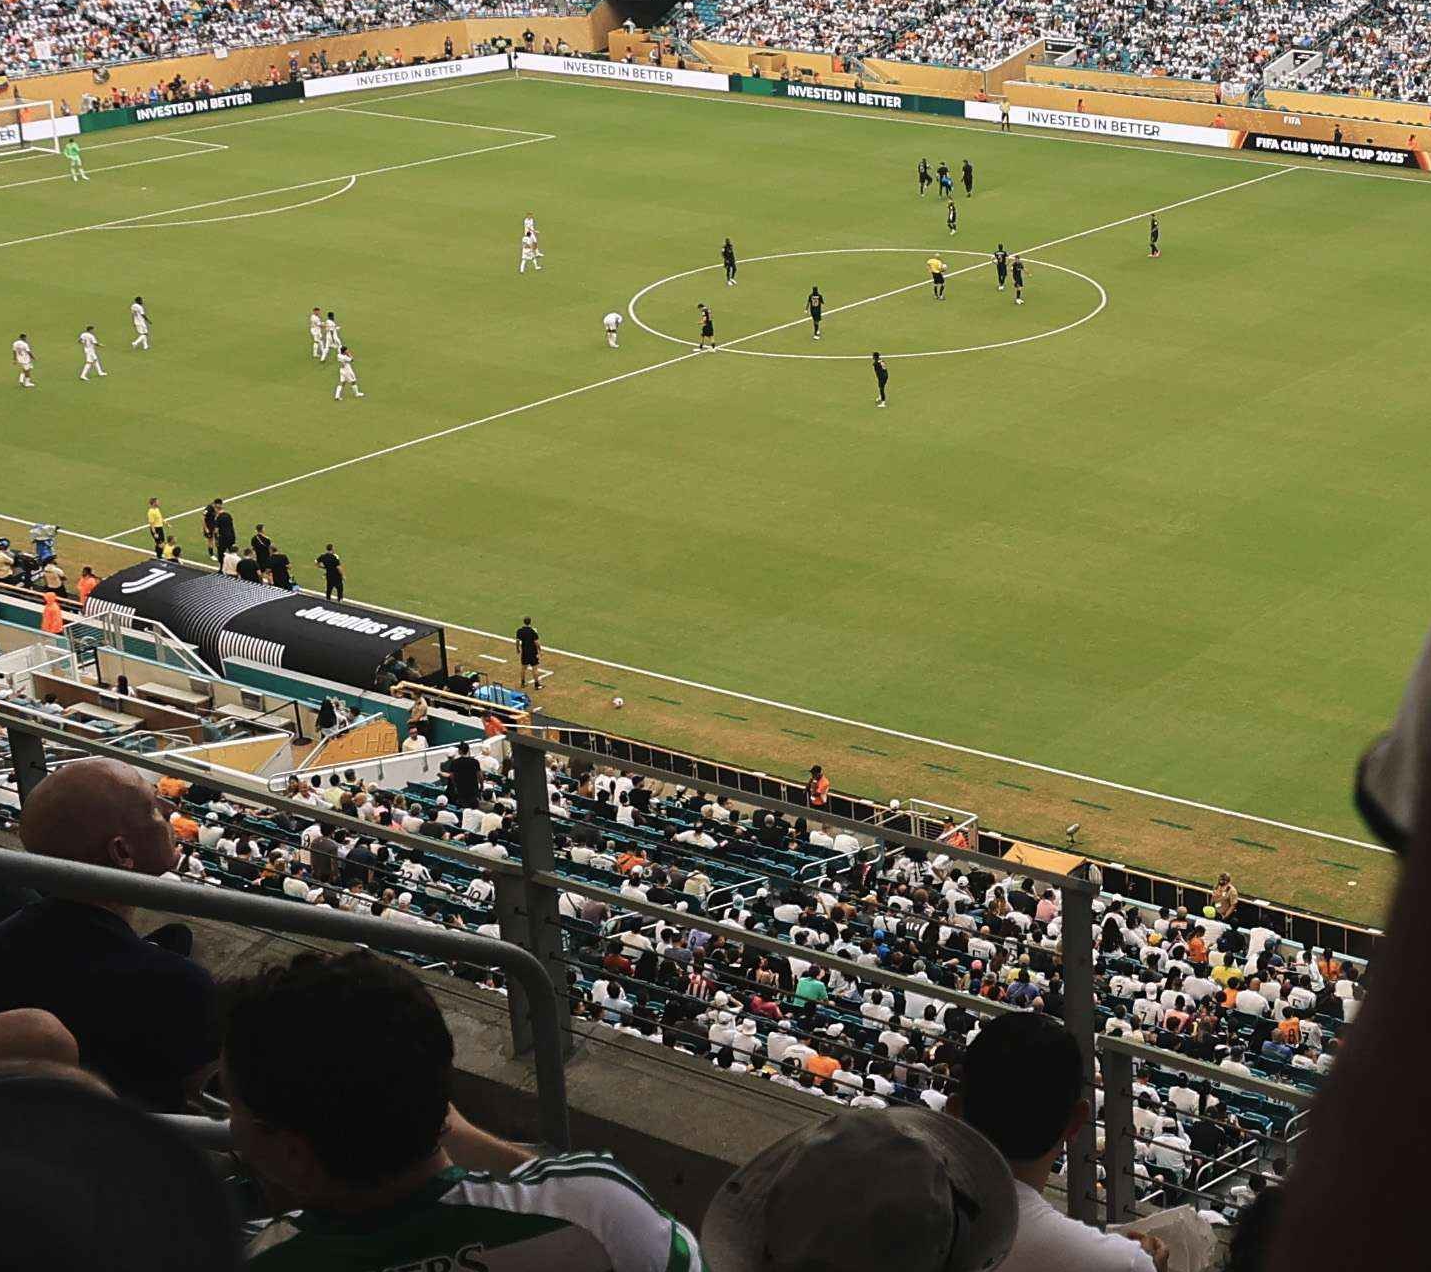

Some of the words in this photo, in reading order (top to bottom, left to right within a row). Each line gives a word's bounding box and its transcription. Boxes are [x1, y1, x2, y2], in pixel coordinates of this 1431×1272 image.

[356, 71, 408, 87] INVESTED
[411, 69, 422, 80] IN
[425, 64, 463, 79] BETTER
[562, 60, 614, 76] INVESTED
[617, 67, 628, 78] IN
[631, 69, 674, 84] BETTER
[136, 102, 193, 122] INVESTED
[196, 99, 209, 113] IN
[212, 92, 252, 110] BETTER
[787, 82, 841, 101] INVESTED
[844, 88, 856, 102] IN
[859, 91, 902, 108] BETTER
[1027, 110, 1090, 129] INVESTED
[1093, 116, 1107, 130] IN
[1110, 118, 1161, 136] BETTER
[1283, 116, 1301, 126] FIFA
[1256, 136, 1277, 150] FIFA
[1279, 137, 1310, 153] CLUB
[1311, 140, 1349, 157] WORLD
[1351, 146, 1375, 160] CUP
[295, 606, 388, 635] Juventus
[379, 625, 416, 641] FC
